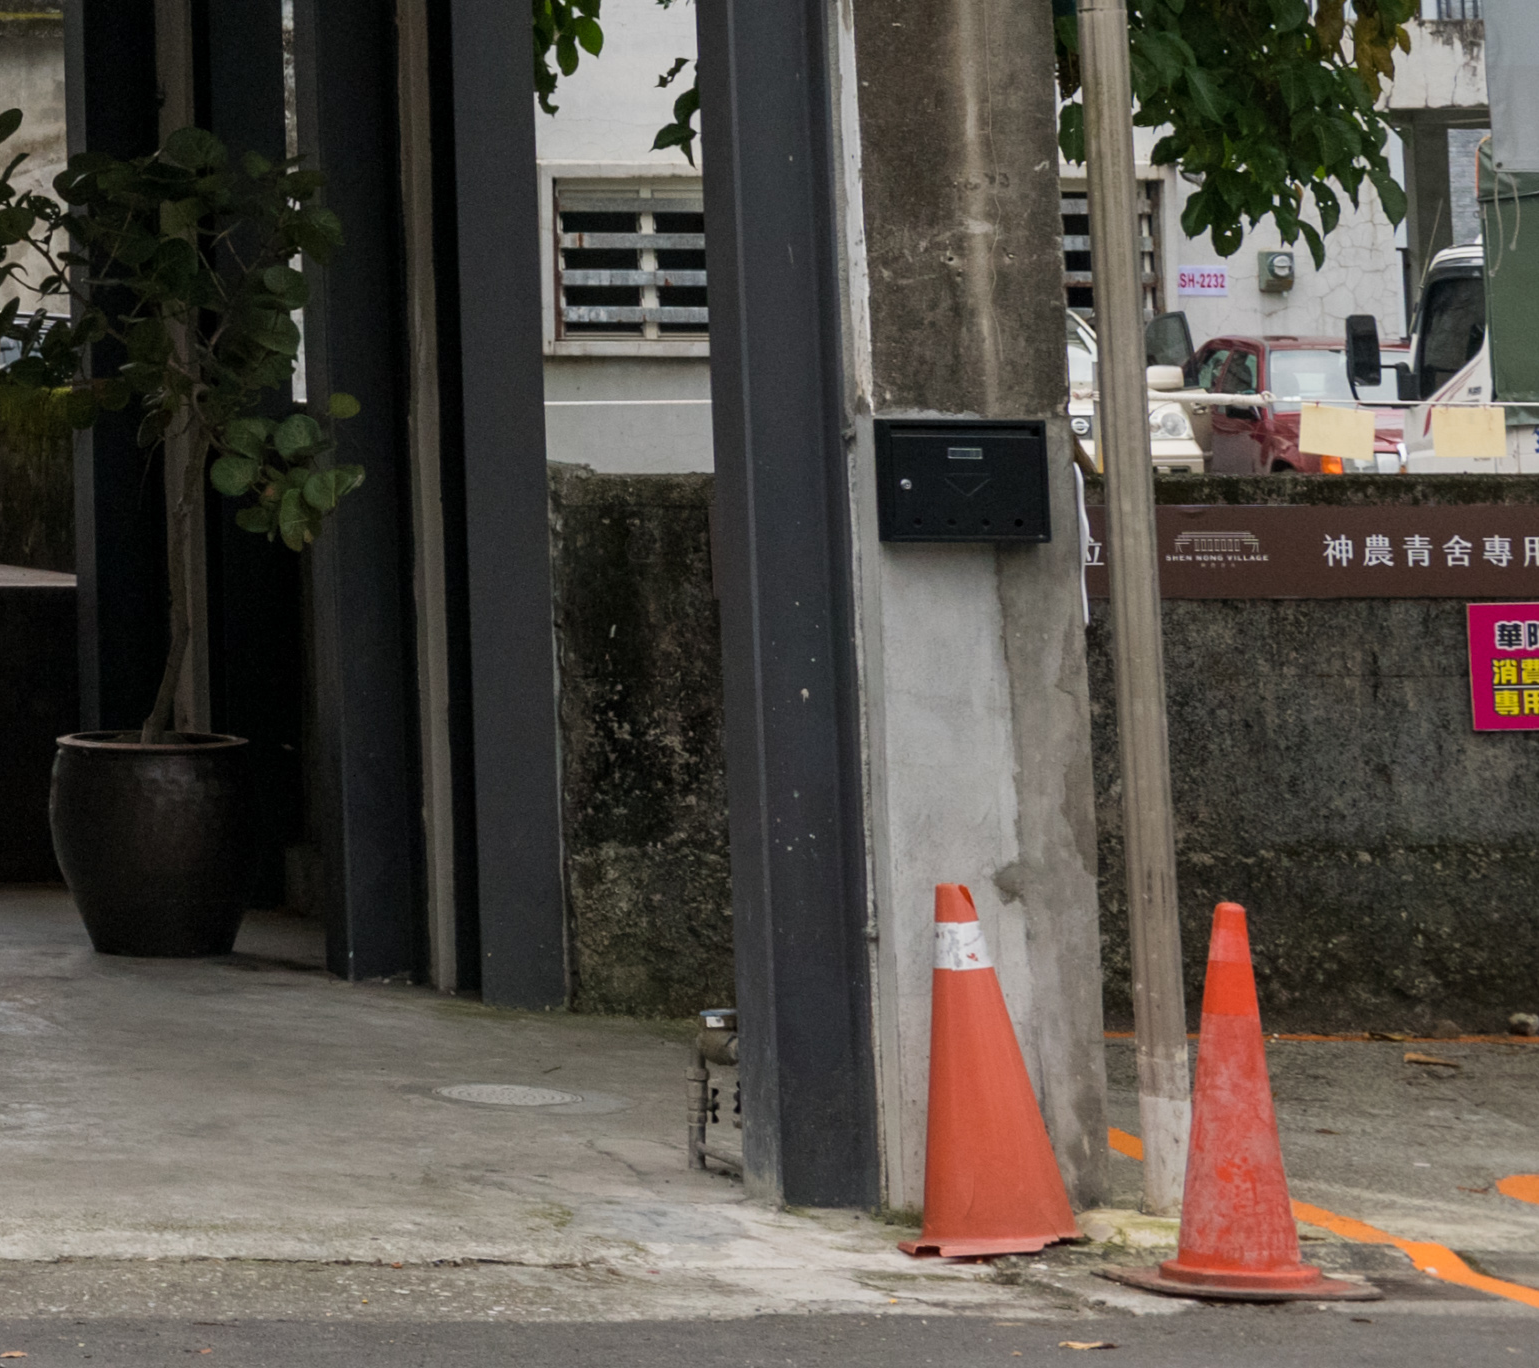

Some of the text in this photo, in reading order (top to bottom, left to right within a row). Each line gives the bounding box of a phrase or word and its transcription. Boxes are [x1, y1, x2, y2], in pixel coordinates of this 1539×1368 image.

[1177, 272, 1226, 289] SH-2232
[1165, 554, 1270, 562] SHEN NONG VILLAGE
